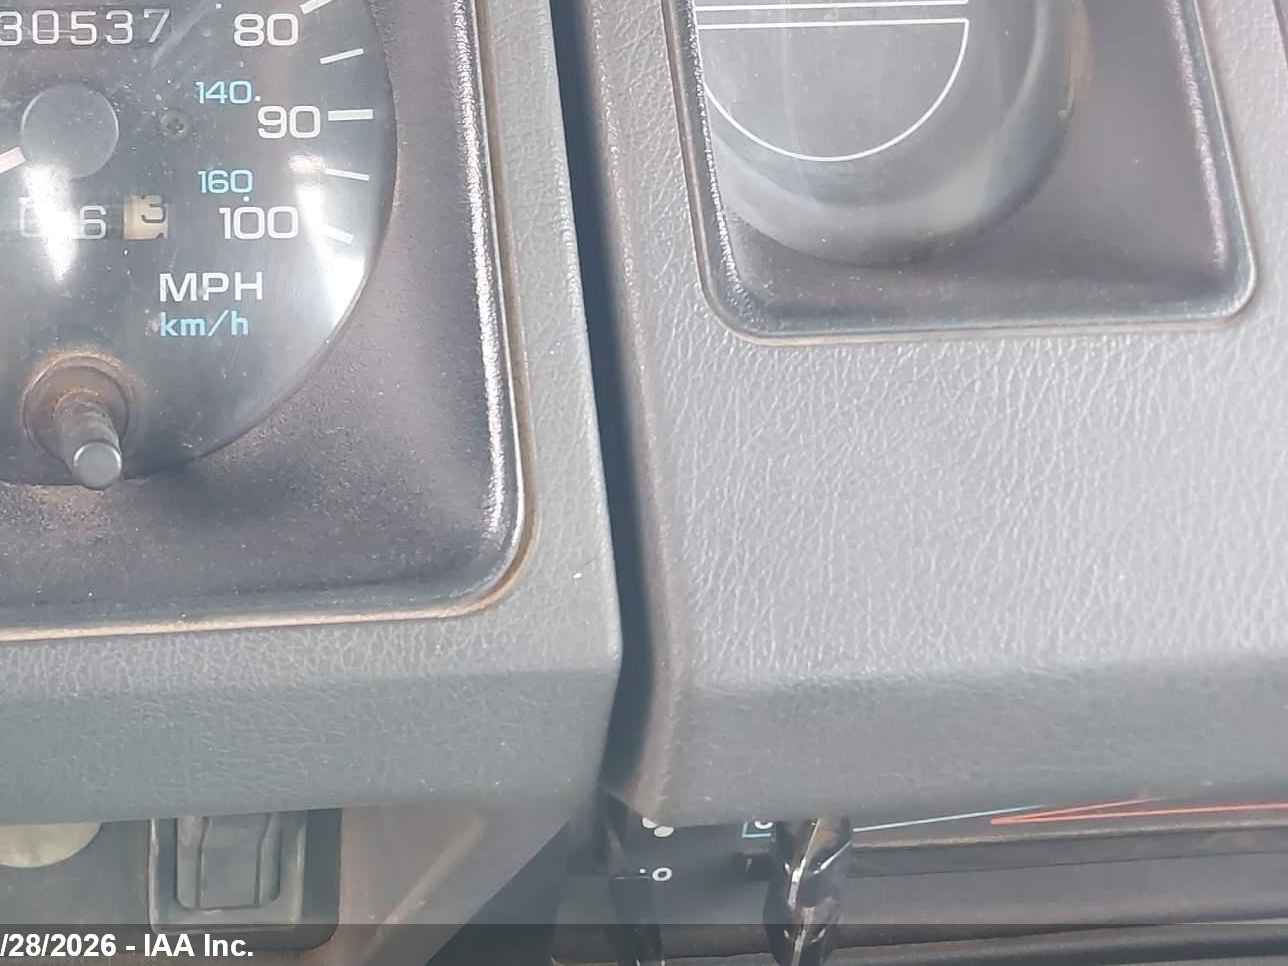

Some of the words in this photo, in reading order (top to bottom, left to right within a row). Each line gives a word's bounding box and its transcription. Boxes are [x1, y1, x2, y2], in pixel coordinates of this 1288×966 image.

[233, 13, 299, 46] 80
[196, 79, 253, 105] 140
[257, 106, 322, 139] 90
[198, 169, 254, 194] 160
[218, 206, 299, 241] 100
[158, 272, 263, 302] MPH
[159, 310, 249, 338] km/h
